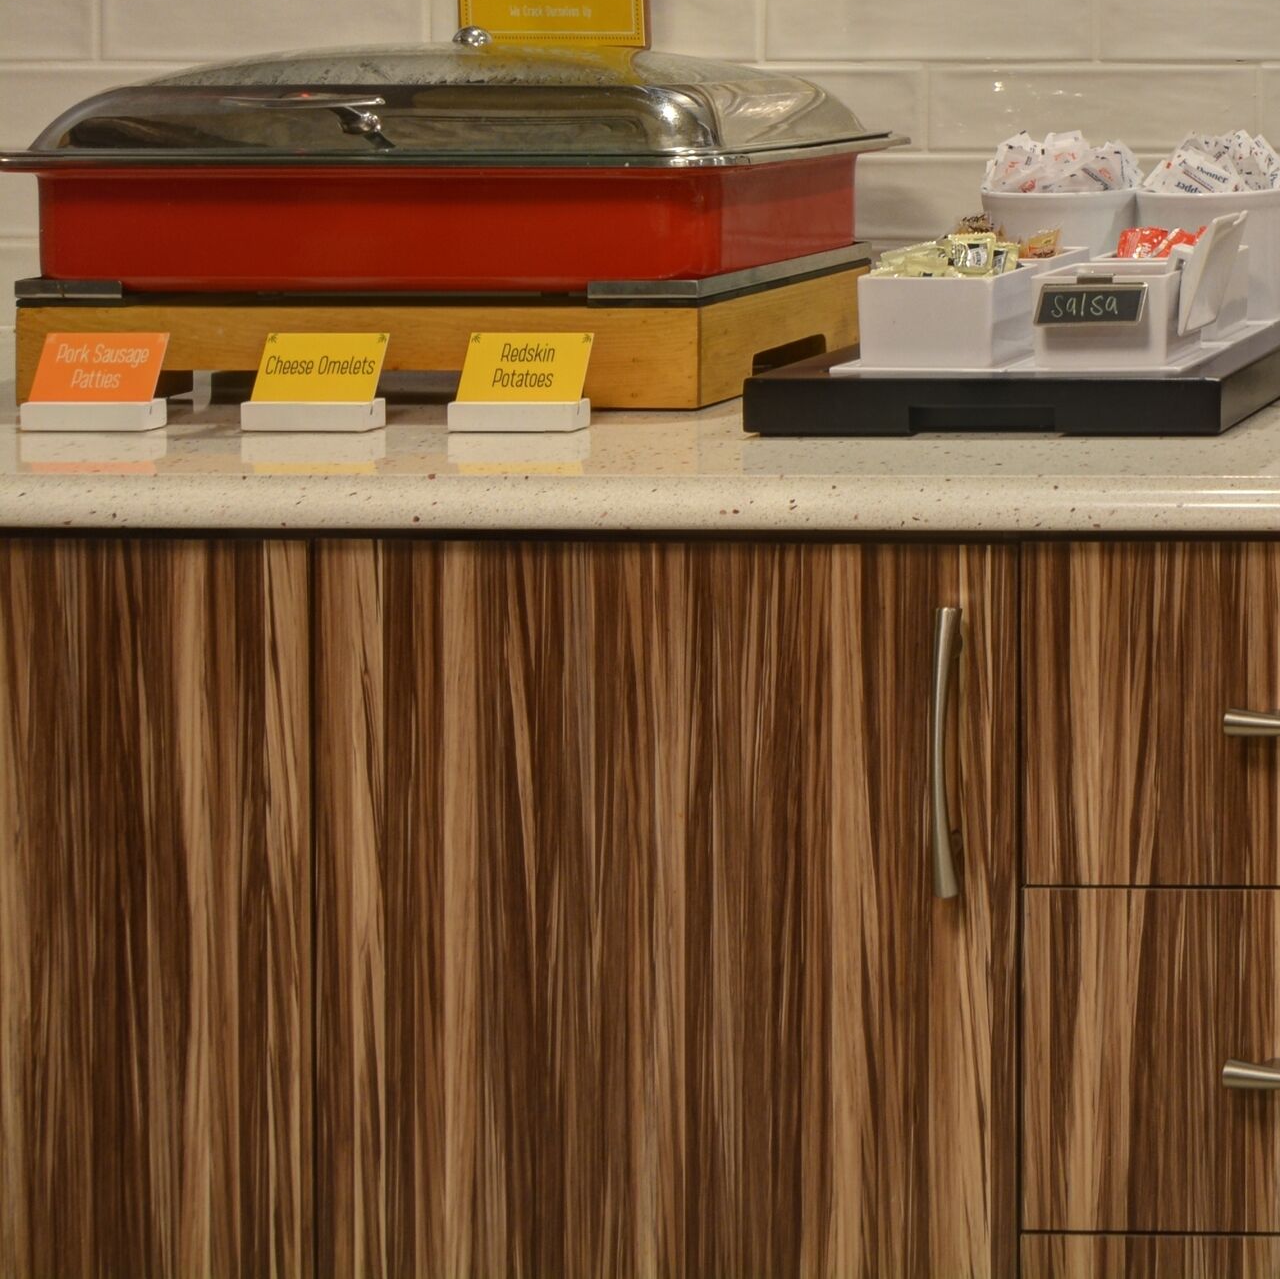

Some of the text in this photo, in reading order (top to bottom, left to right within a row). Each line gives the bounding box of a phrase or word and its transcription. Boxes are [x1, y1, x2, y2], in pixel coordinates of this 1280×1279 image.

[56, 343, 149, 368] Pork Sausage
[500, 343, 556, 362] Redskin
[265, 355, 376, 375] Cheese Omelets
[70, 369, 121, 389] Patties
[492, 368, 554, 388] Potatoes
